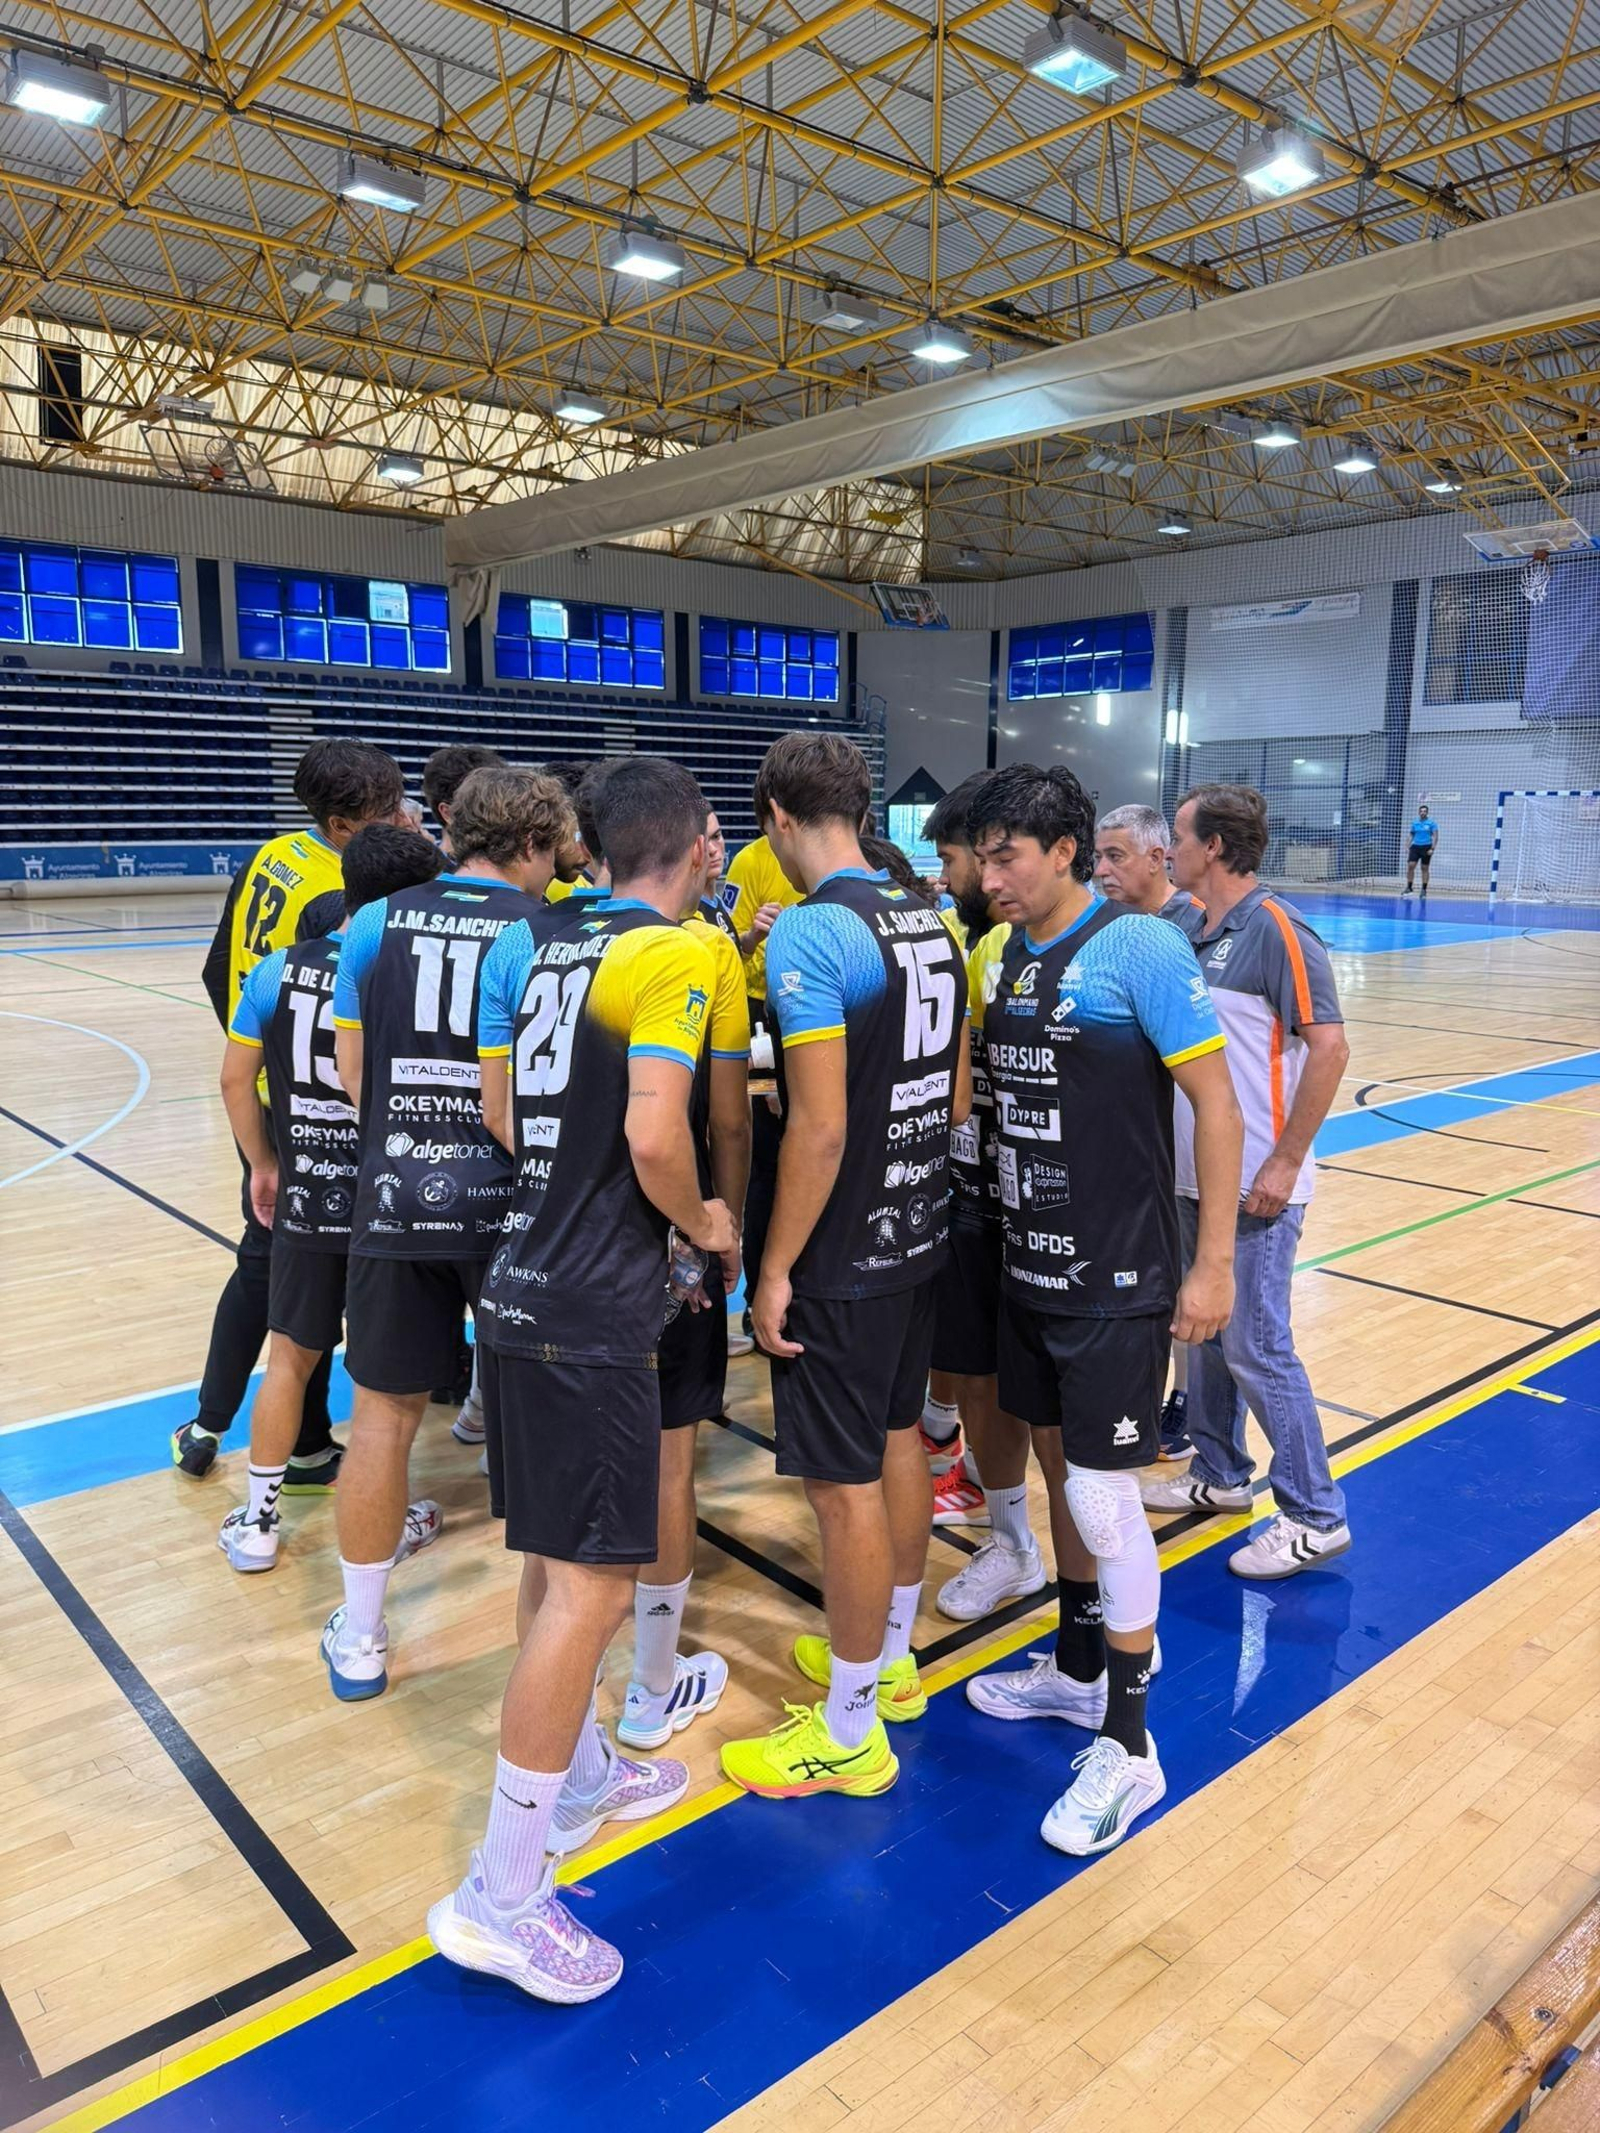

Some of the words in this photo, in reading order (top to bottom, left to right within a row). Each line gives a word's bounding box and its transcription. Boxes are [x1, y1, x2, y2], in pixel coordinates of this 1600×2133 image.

[243, 872, 287, 958] 12
[298, 966, 321, 989] DE
[411, 935, 482, 1037] 11
[892, 937, 956, 1062] 15
[516, 965, 591, 1097] 29
[1044, 1024, 1080, 1034] Domino's
[1050, 1033, 1072, 1041] Pizza
[398, 1064, 481, 1080] VITALDENT
[388, 1113, 451, 1123] FITNESS
[1009, 1107, 1046, 1126] DYPRE
[412, 1138, 496, 1164] algetoner
[1034, 1163, 1066, 1179] DESIGN
[1028, 1230, 1076, 1256] DFDS
